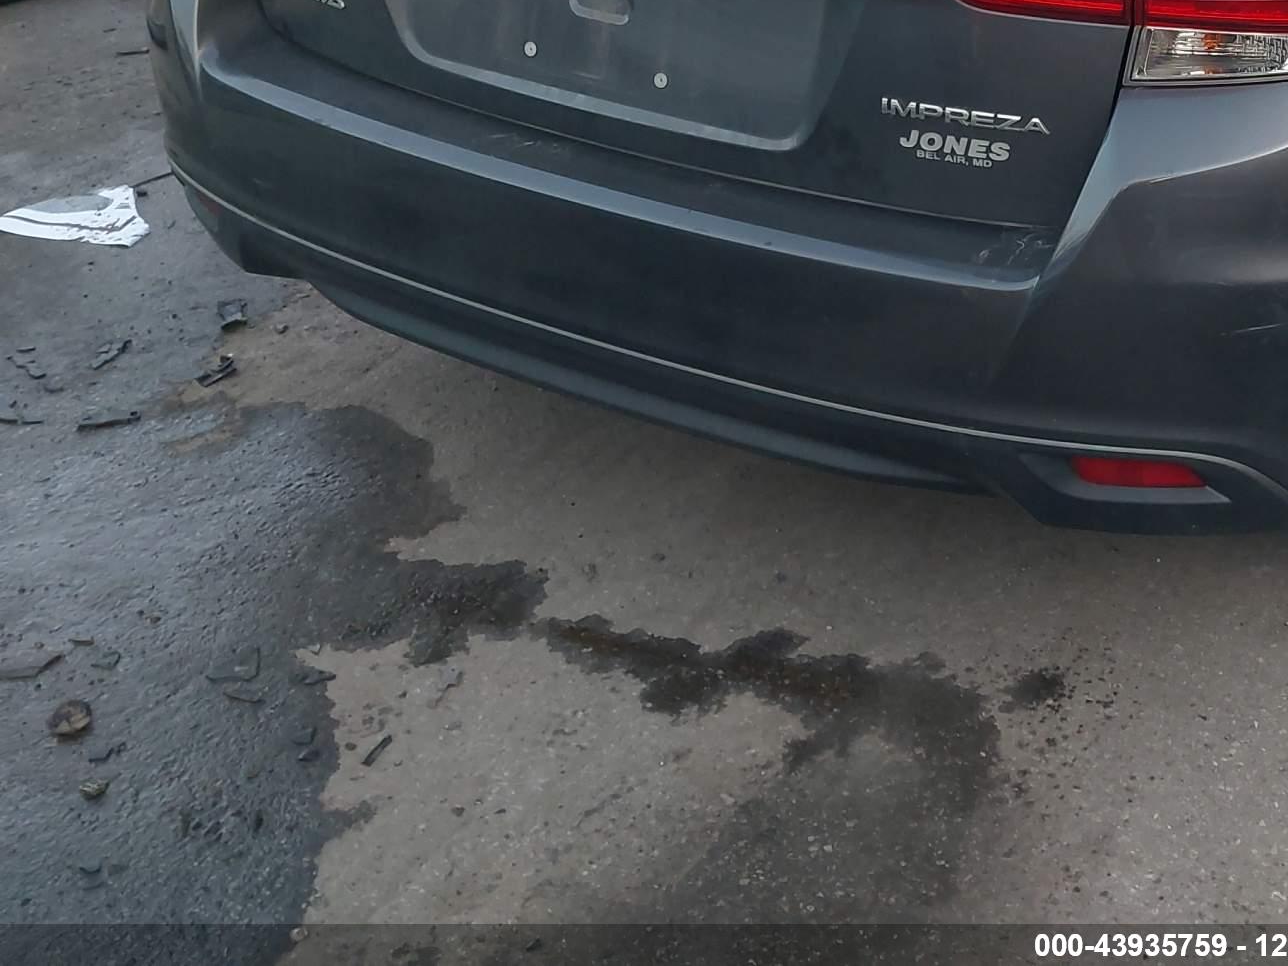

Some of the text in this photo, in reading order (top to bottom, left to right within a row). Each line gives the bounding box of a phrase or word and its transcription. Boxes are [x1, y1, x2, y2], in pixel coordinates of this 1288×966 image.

[880, 96, 1051, 135] IMPREZA
[899, 129, 1012, 162] JONES
[915, 149, 994, 169] BEL AIR, MD
